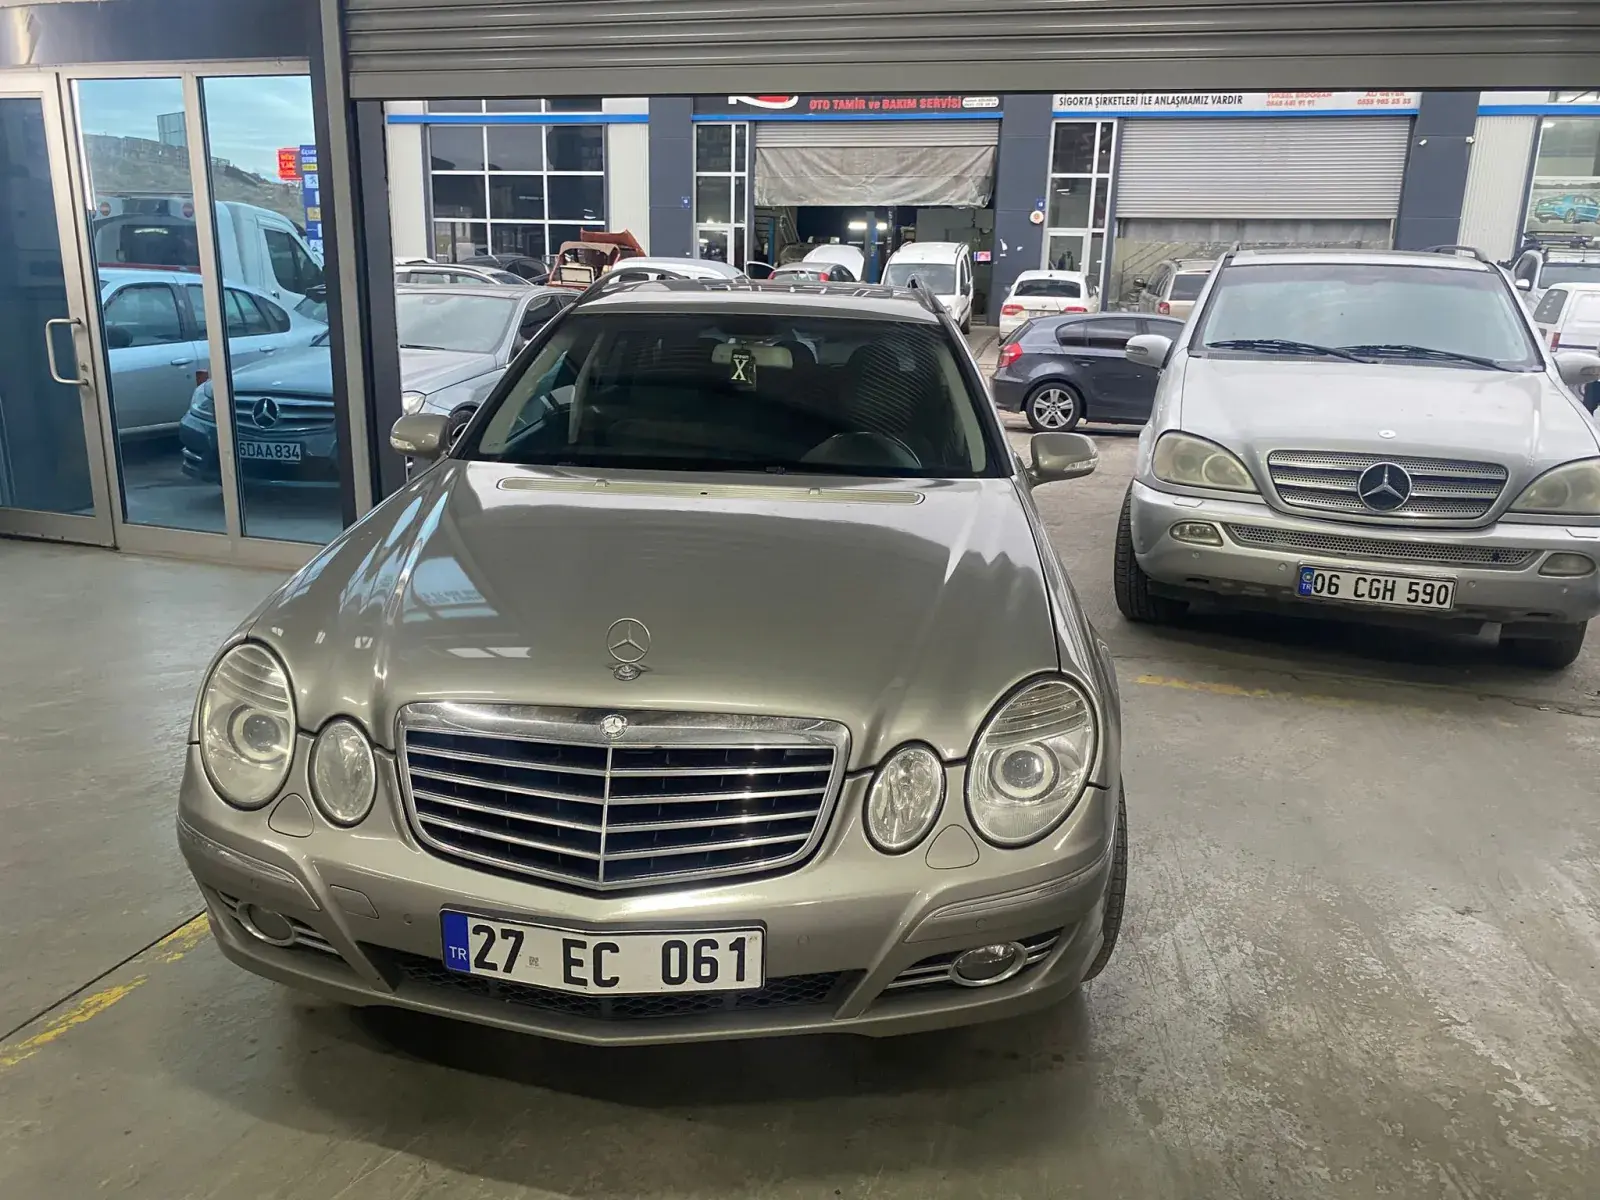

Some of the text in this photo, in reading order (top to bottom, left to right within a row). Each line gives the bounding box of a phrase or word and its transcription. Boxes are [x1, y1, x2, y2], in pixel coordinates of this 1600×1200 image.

[809, 99, 831, 110] OTO
[833, 97, 866, 110] TAMİR
[868, 100, 881, 110] ve
[882, 98, 917, 109] BAKIM
[919, 96, 961, 109] SERVİSİ
[1059, 94, 1243, 108] SİGORTA ŞİRKETLERİ İLE ANLAŞMAMIZ VARDIR
[731, 359, 749, 381] X
[240, 442, 300, 459] 6DAA834
[1302, 572, 1450, 606] TR 06 CGH 590
[449, 923, 747, 988] TR 27 EC 061
